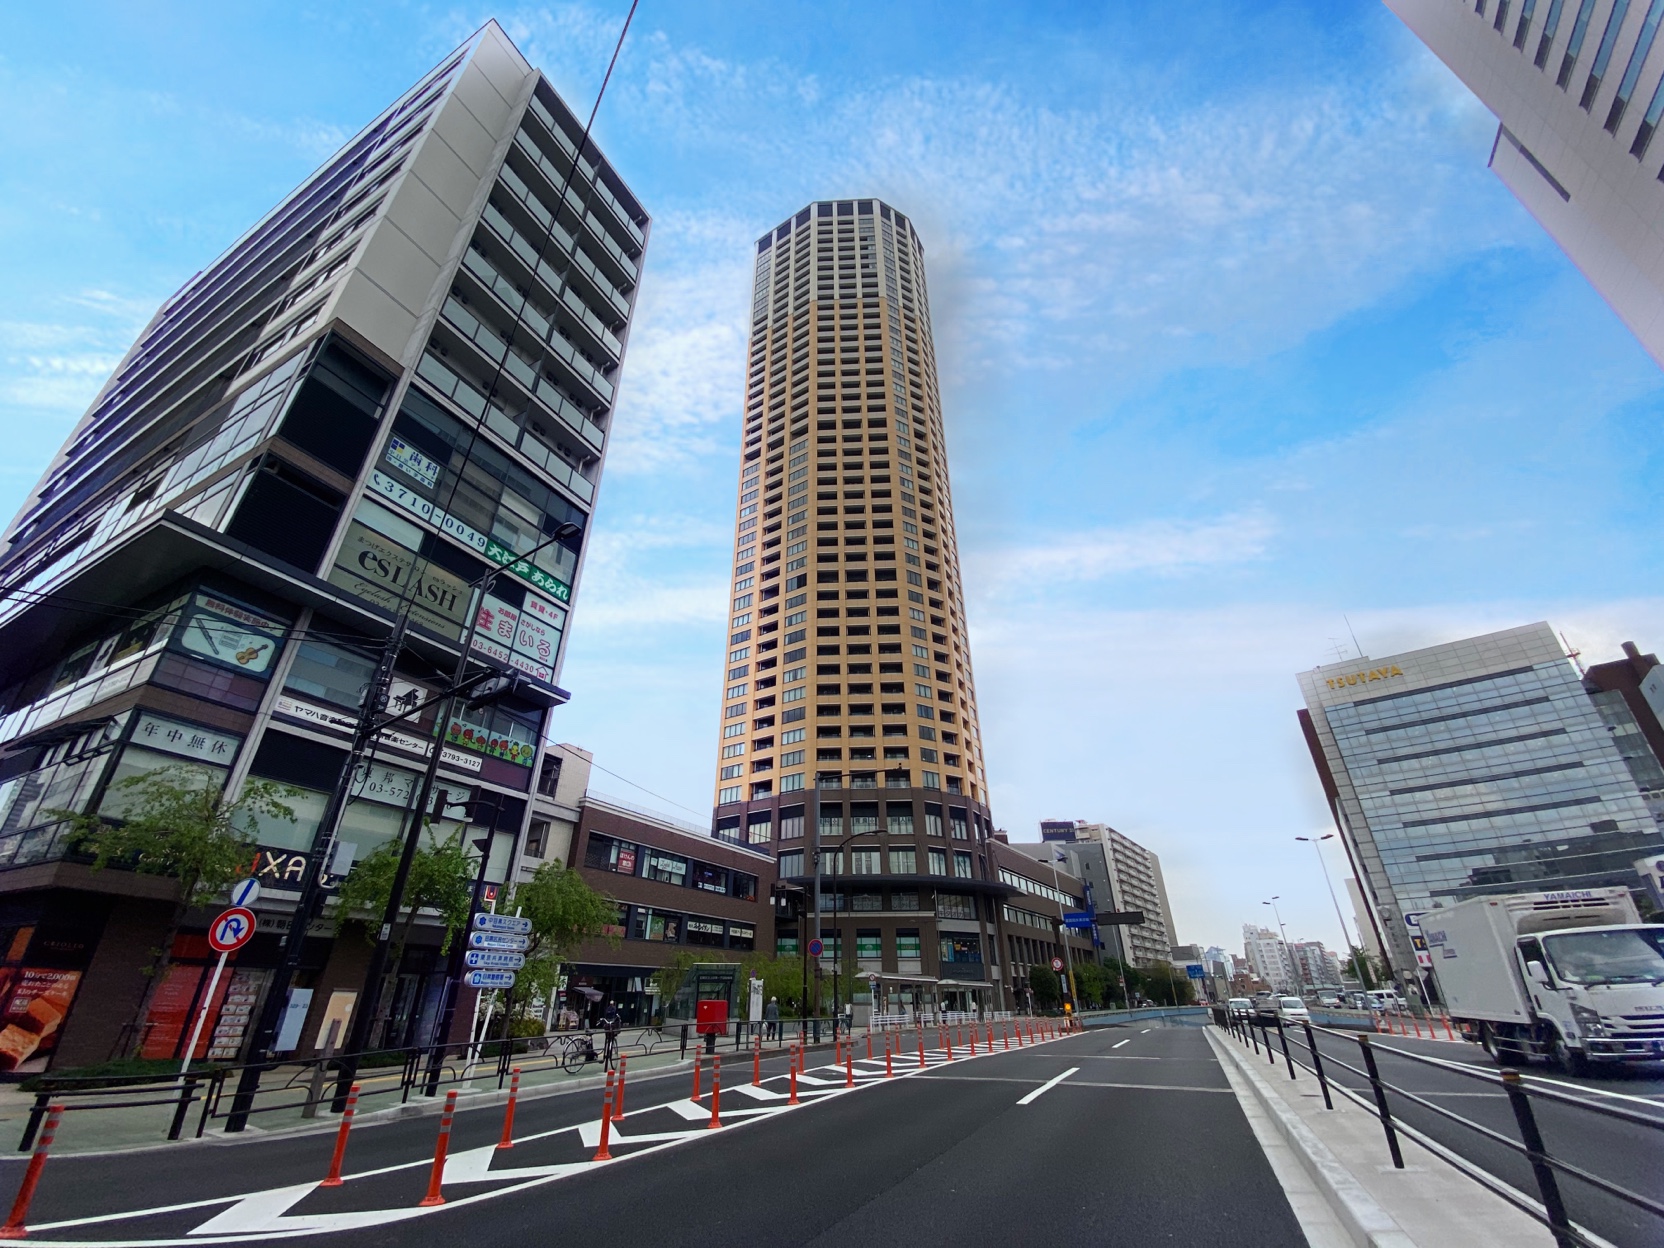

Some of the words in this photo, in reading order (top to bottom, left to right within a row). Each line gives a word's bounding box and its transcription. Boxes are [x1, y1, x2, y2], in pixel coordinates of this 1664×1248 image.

[384, 481, 486, 548] 3710-0049
[401, 601, 446, 629] Etensions
[472, 639, 534, 673] 03-6452-4430
[1326, 665, 1403, 689] TSUTAYA
[144, 722, 228, 754] 年中無休
[1544, 891, 1592, 900] YAMAICHI
